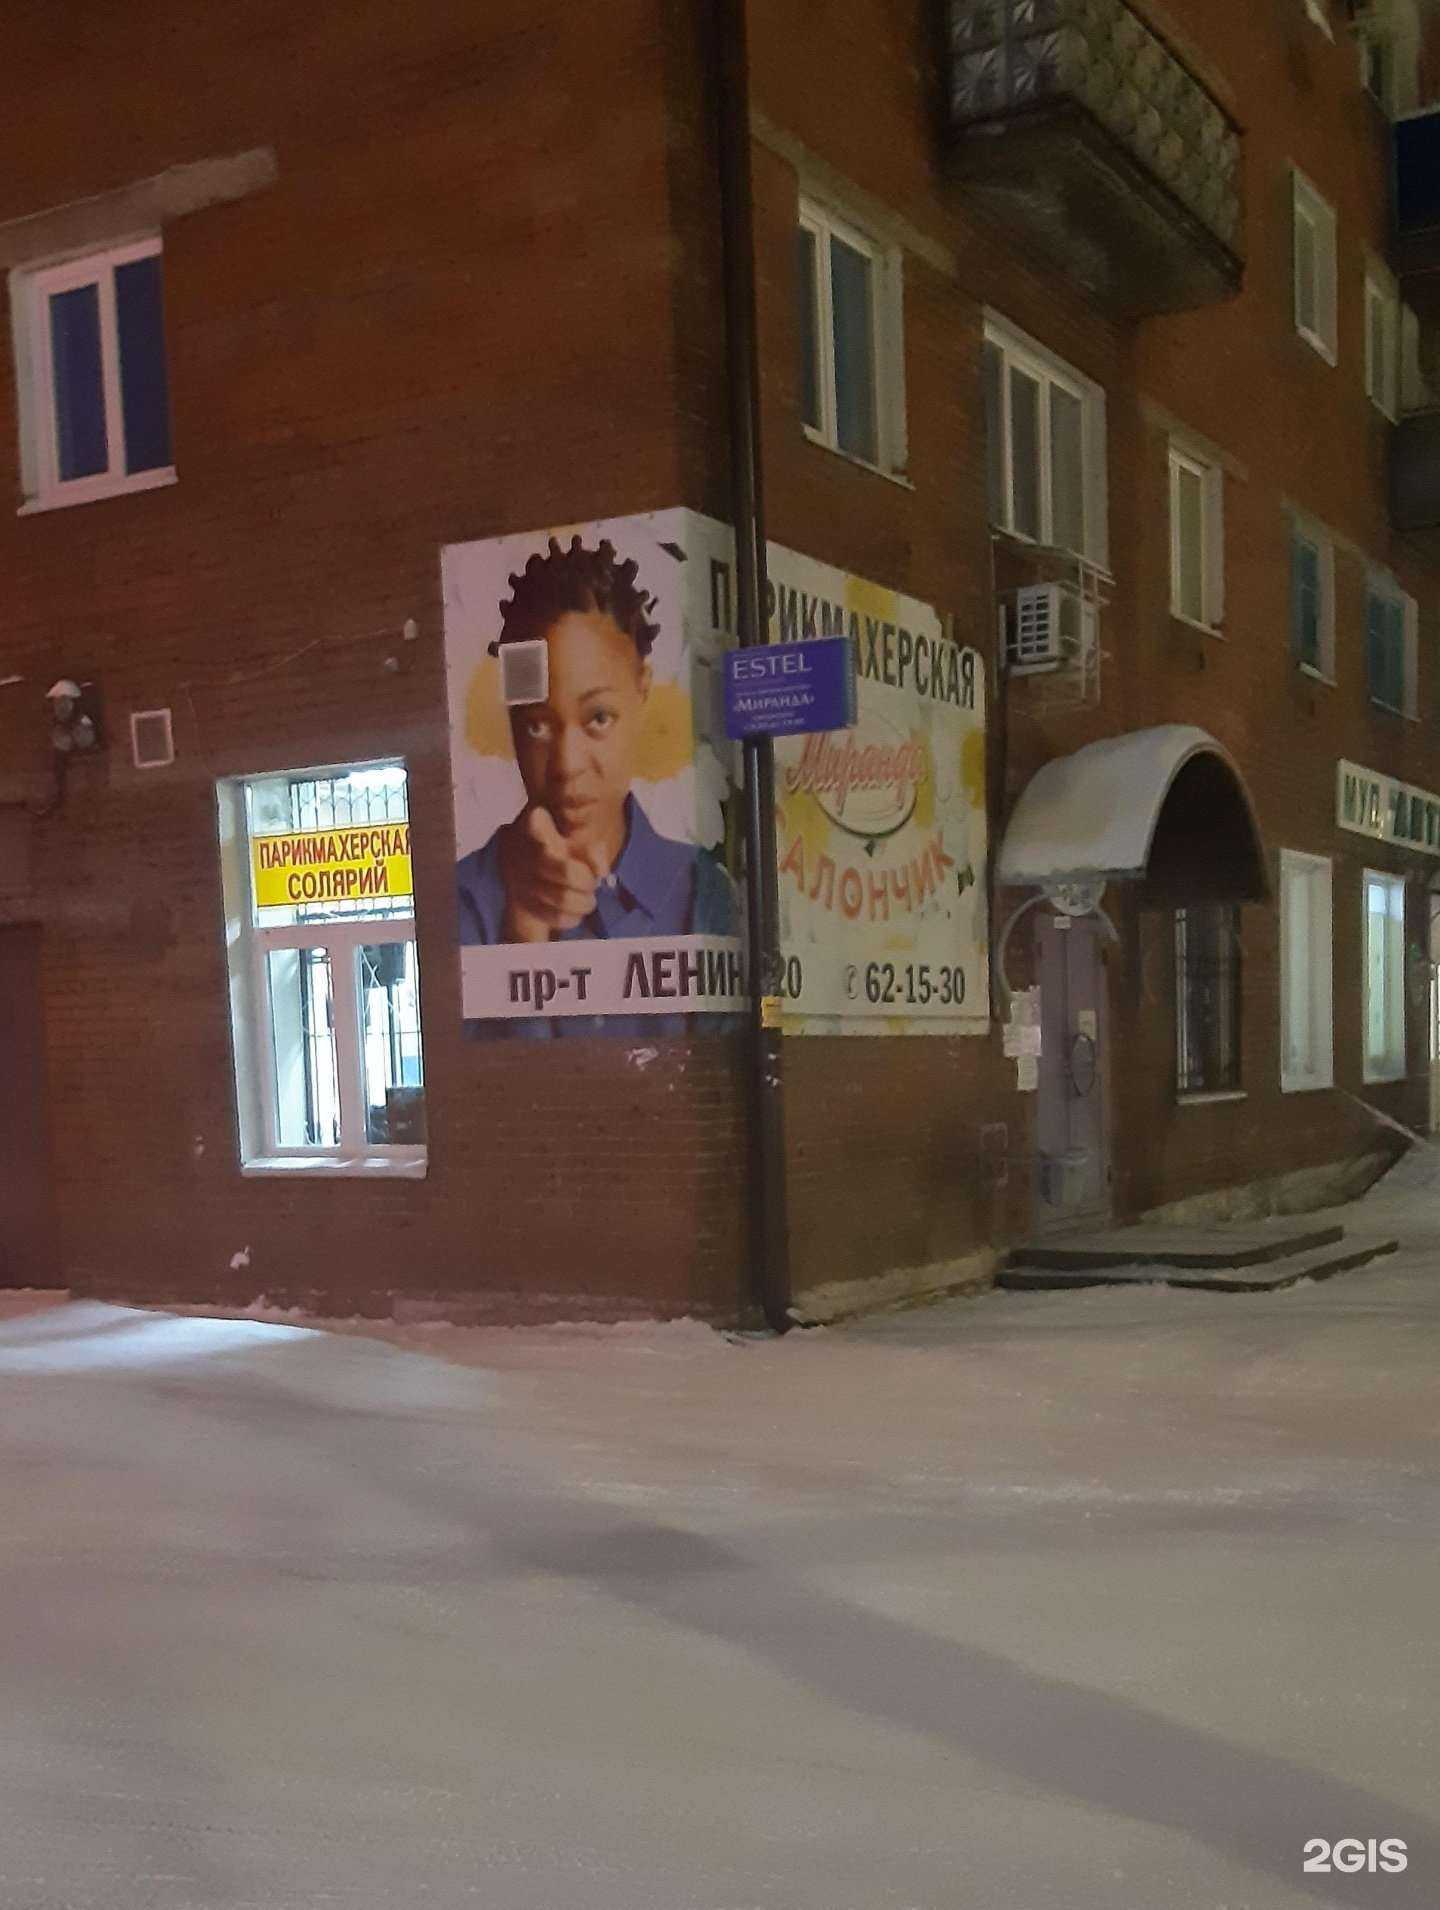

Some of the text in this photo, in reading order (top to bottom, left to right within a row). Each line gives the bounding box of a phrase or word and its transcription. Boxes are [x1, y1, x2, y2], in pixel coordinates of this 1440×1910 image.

[711, 558, 976, 712] ПРИКМАХЕРСКАЯ
[733, 652, 813, 681] ESTEL
[288, 858, 389, 900] СОЛЯРИЙ
[776, 808, 955, 922] АЛОНЧИК
[509, 967, 592, 1011] пр-т
[622, 949, 744, 999] ЛЕНИН
[865, 961, 966, 1005] 62-15-30
